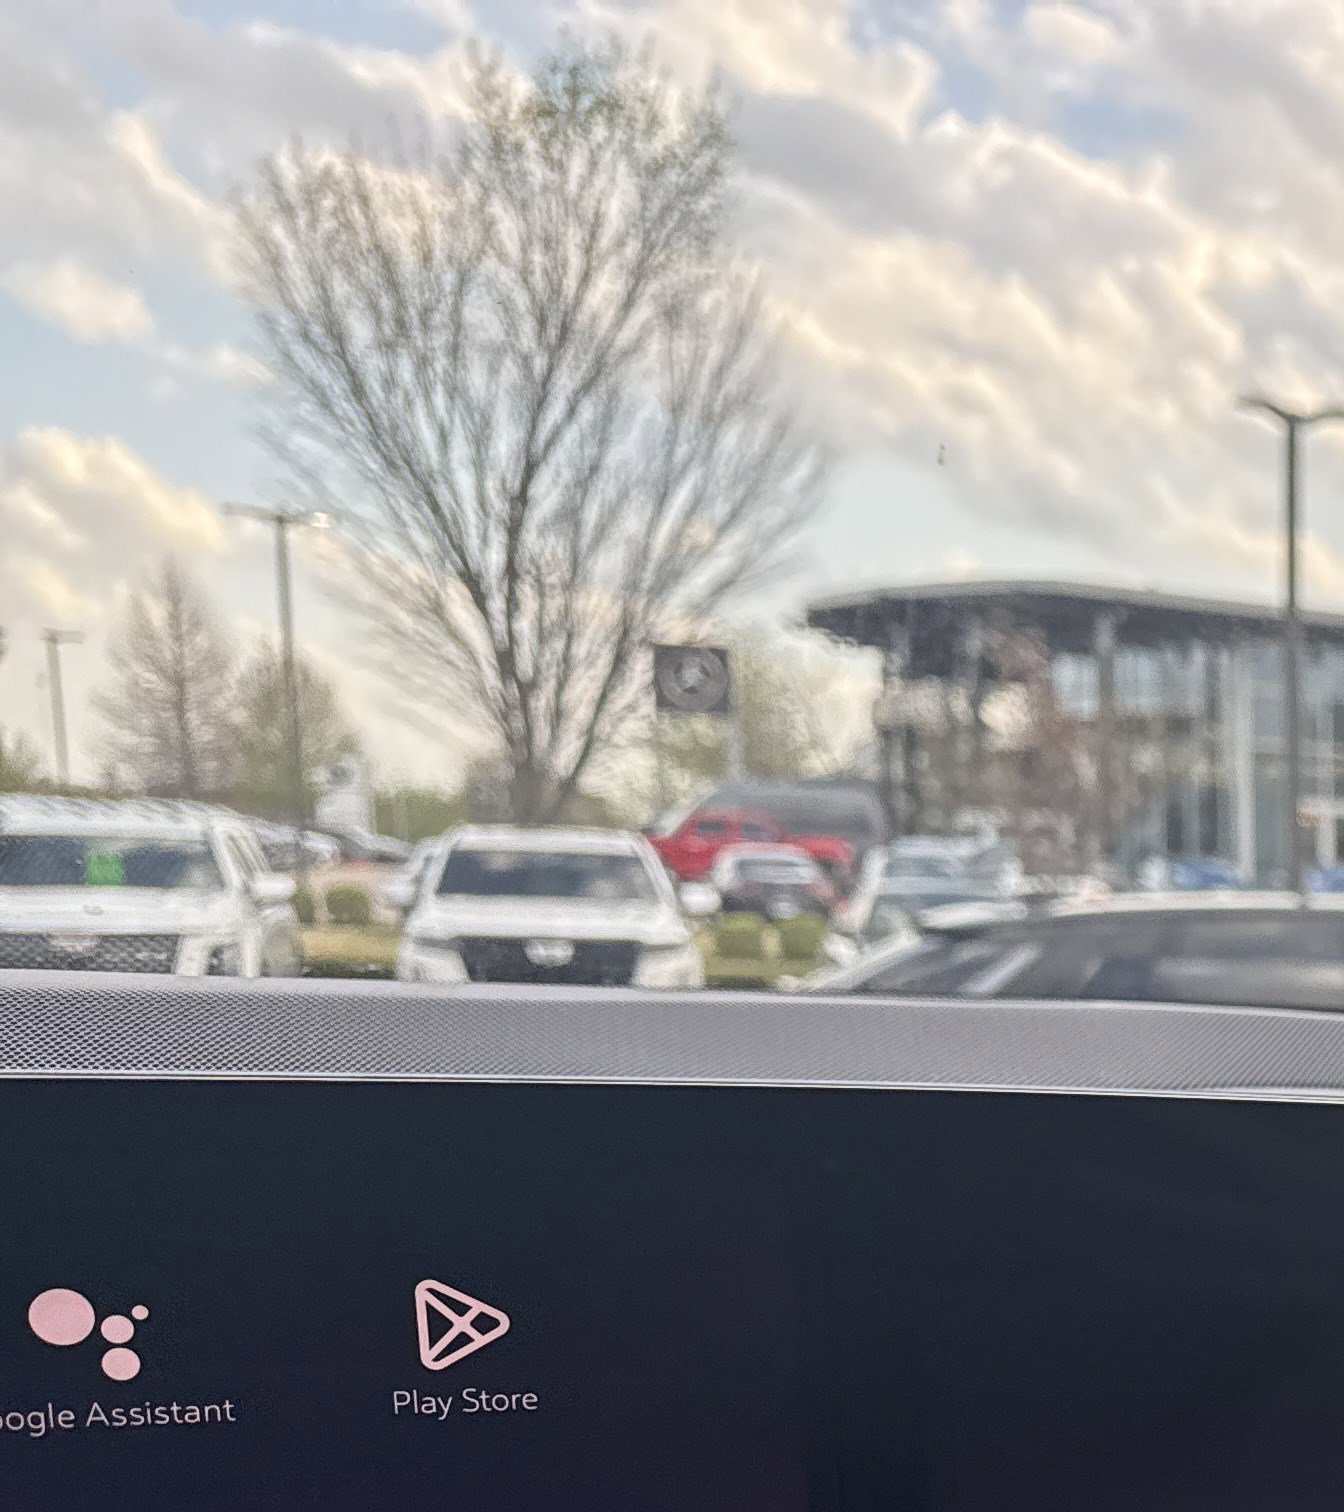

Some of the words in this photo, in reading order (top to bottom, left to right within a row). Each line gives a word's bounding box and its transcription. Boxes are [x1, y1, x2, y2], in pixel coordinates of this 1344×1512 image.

[0, 1402, 75, 1437] ogle
[86, 1400, 237, 1427] Assistant
[393, 1389, 452, 1420] Play
[462, 1388, 539, 1413] Store
